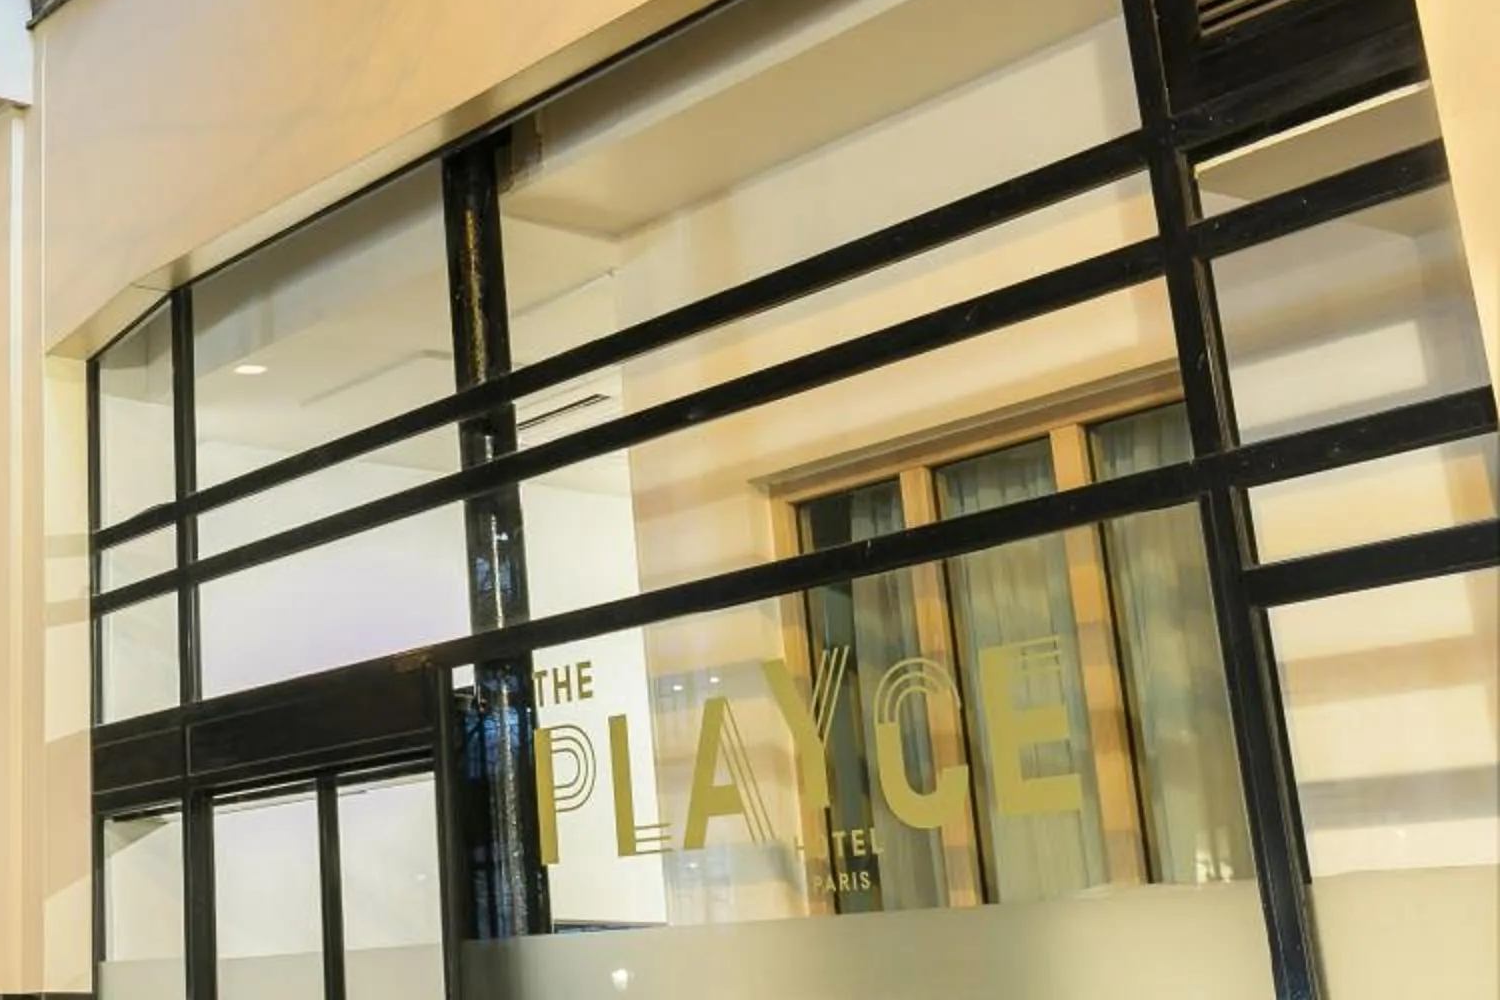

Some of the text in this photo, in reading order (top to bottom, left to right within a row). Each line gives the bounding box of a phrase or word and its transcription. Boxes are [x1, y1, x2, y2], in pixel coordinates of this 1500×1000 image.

[534, 661, 593, 706] THE
[534, 635, 1082, 866] PLAYCE
[813, 871, 871, 894] PARIS
